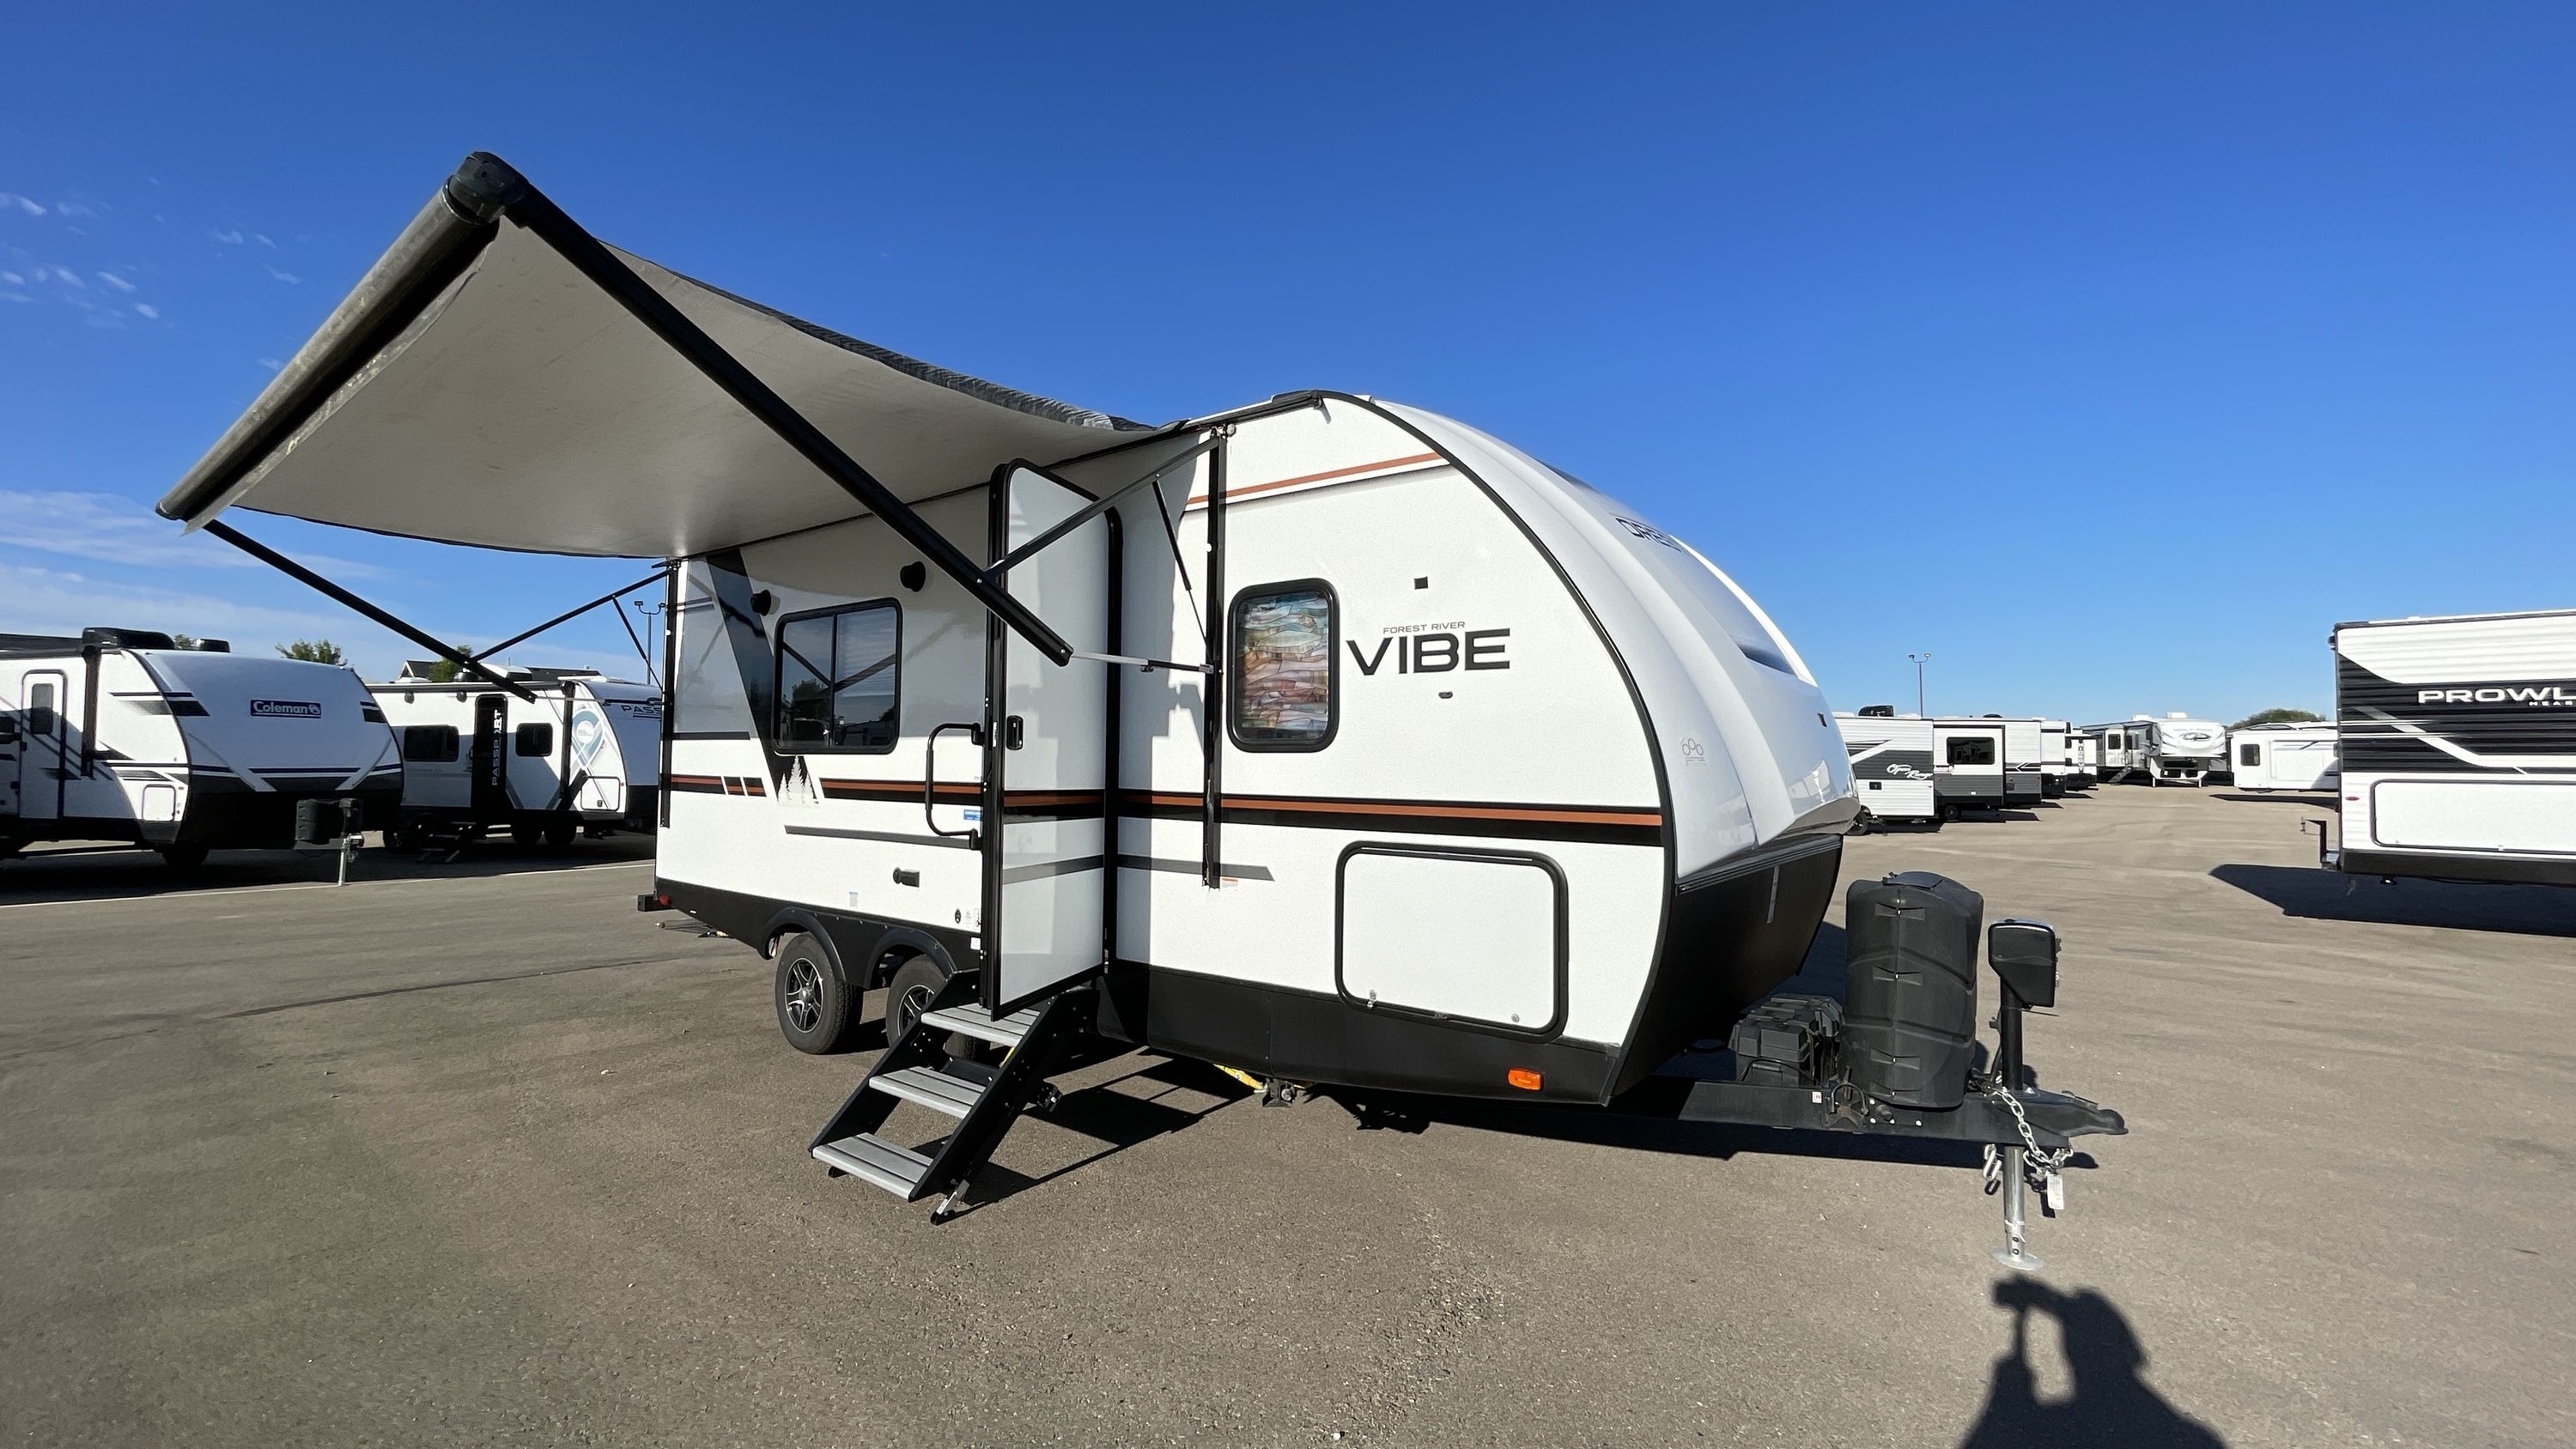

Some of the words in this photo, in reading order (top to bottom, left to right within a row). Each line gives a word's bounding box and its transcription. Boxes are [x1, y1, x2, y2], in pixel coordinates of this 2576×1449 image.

[1382, 624, 1427, 634] FOREST
[1431, 621, 1466, 630] RIVER
[1346, 627, 1510, 676] VIBE
[2418, 687, 2576, 704] PROWL
[253, 700, 308, 713] Coleman
